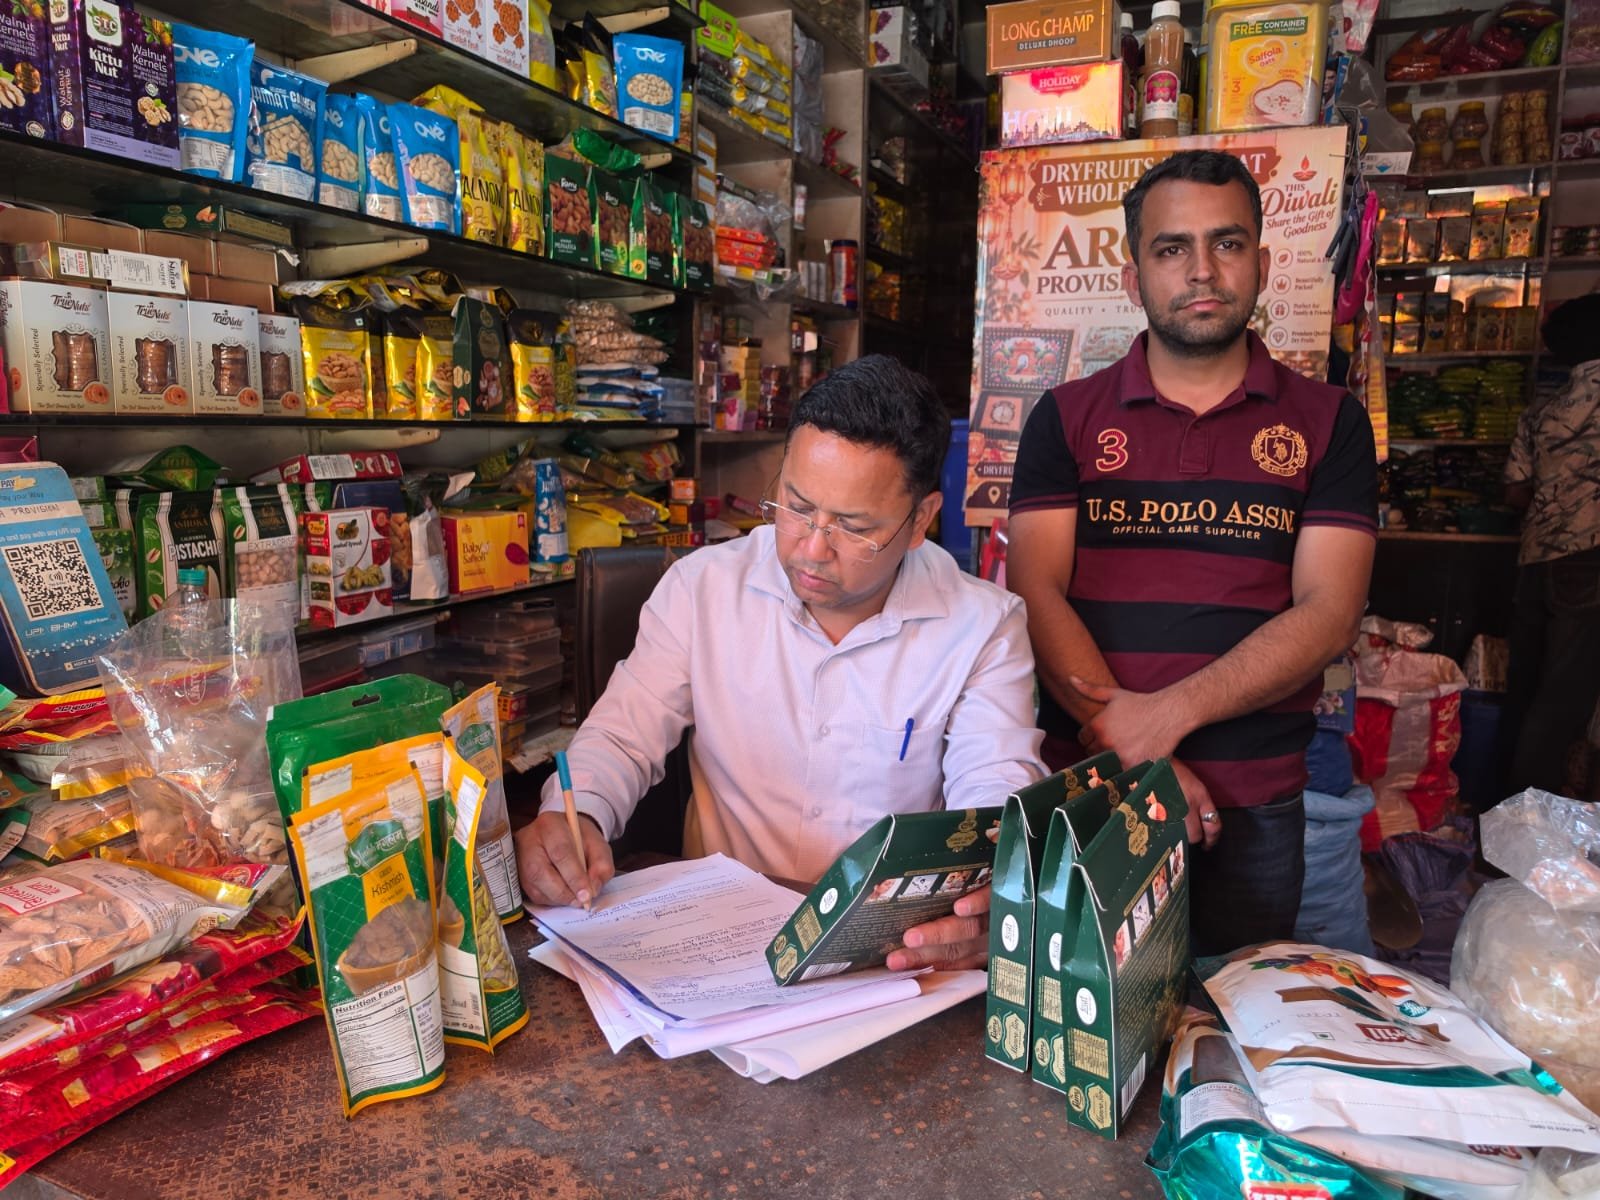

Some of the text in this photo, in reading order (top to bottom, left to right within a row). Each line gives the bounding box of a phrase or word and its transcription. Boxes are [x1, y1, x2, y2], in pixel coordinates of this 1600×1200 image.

[0, 24, 35, 41] ernels
[93, 15, 117, 32] STC
[1001, 14, 1095, 41] LONG CHAMP
[1233, 22, 1263, 35] FREE
[1264, 19, 1305, 29] CONTAINER
[131, 42, 167, 64] Walnut
[1019, 37, 1075, 50] DELUXE DHOOP
[89, 47, 122, 68] Kittu
[132, 53, 168, 73] Kernels
[1248, 47, 1283, 64] Saffola
[95, 61, 118, 78] Nut
[1039, 75, 1081, 89] HOLIDAY
[1042, 157, 1155, 184] DRYFRUITS
[1262, 177, 1339, 217] Diwali
[1285, 184, 1306, 192] THIS
[1265, 207, 1336, 230] Share the Gift of
[1283, 222, 1328, 240] Goodness
[1045, 307, 1094, 317] QUALITY
[35, 356, 44, 392] Specially
[1096, 428, 1128, 471] 3
[983, 462, 1014, 475] DRYFRU
[1087, 498, 1296, 534] U.S. POLO ASSN
[1112, 525, 1261, 540] OFFICIAL GAME SUPPLIER
[372, 872, 405, 898] Kishmish
[335, 984, 402, 1014] Nutrition Facts
